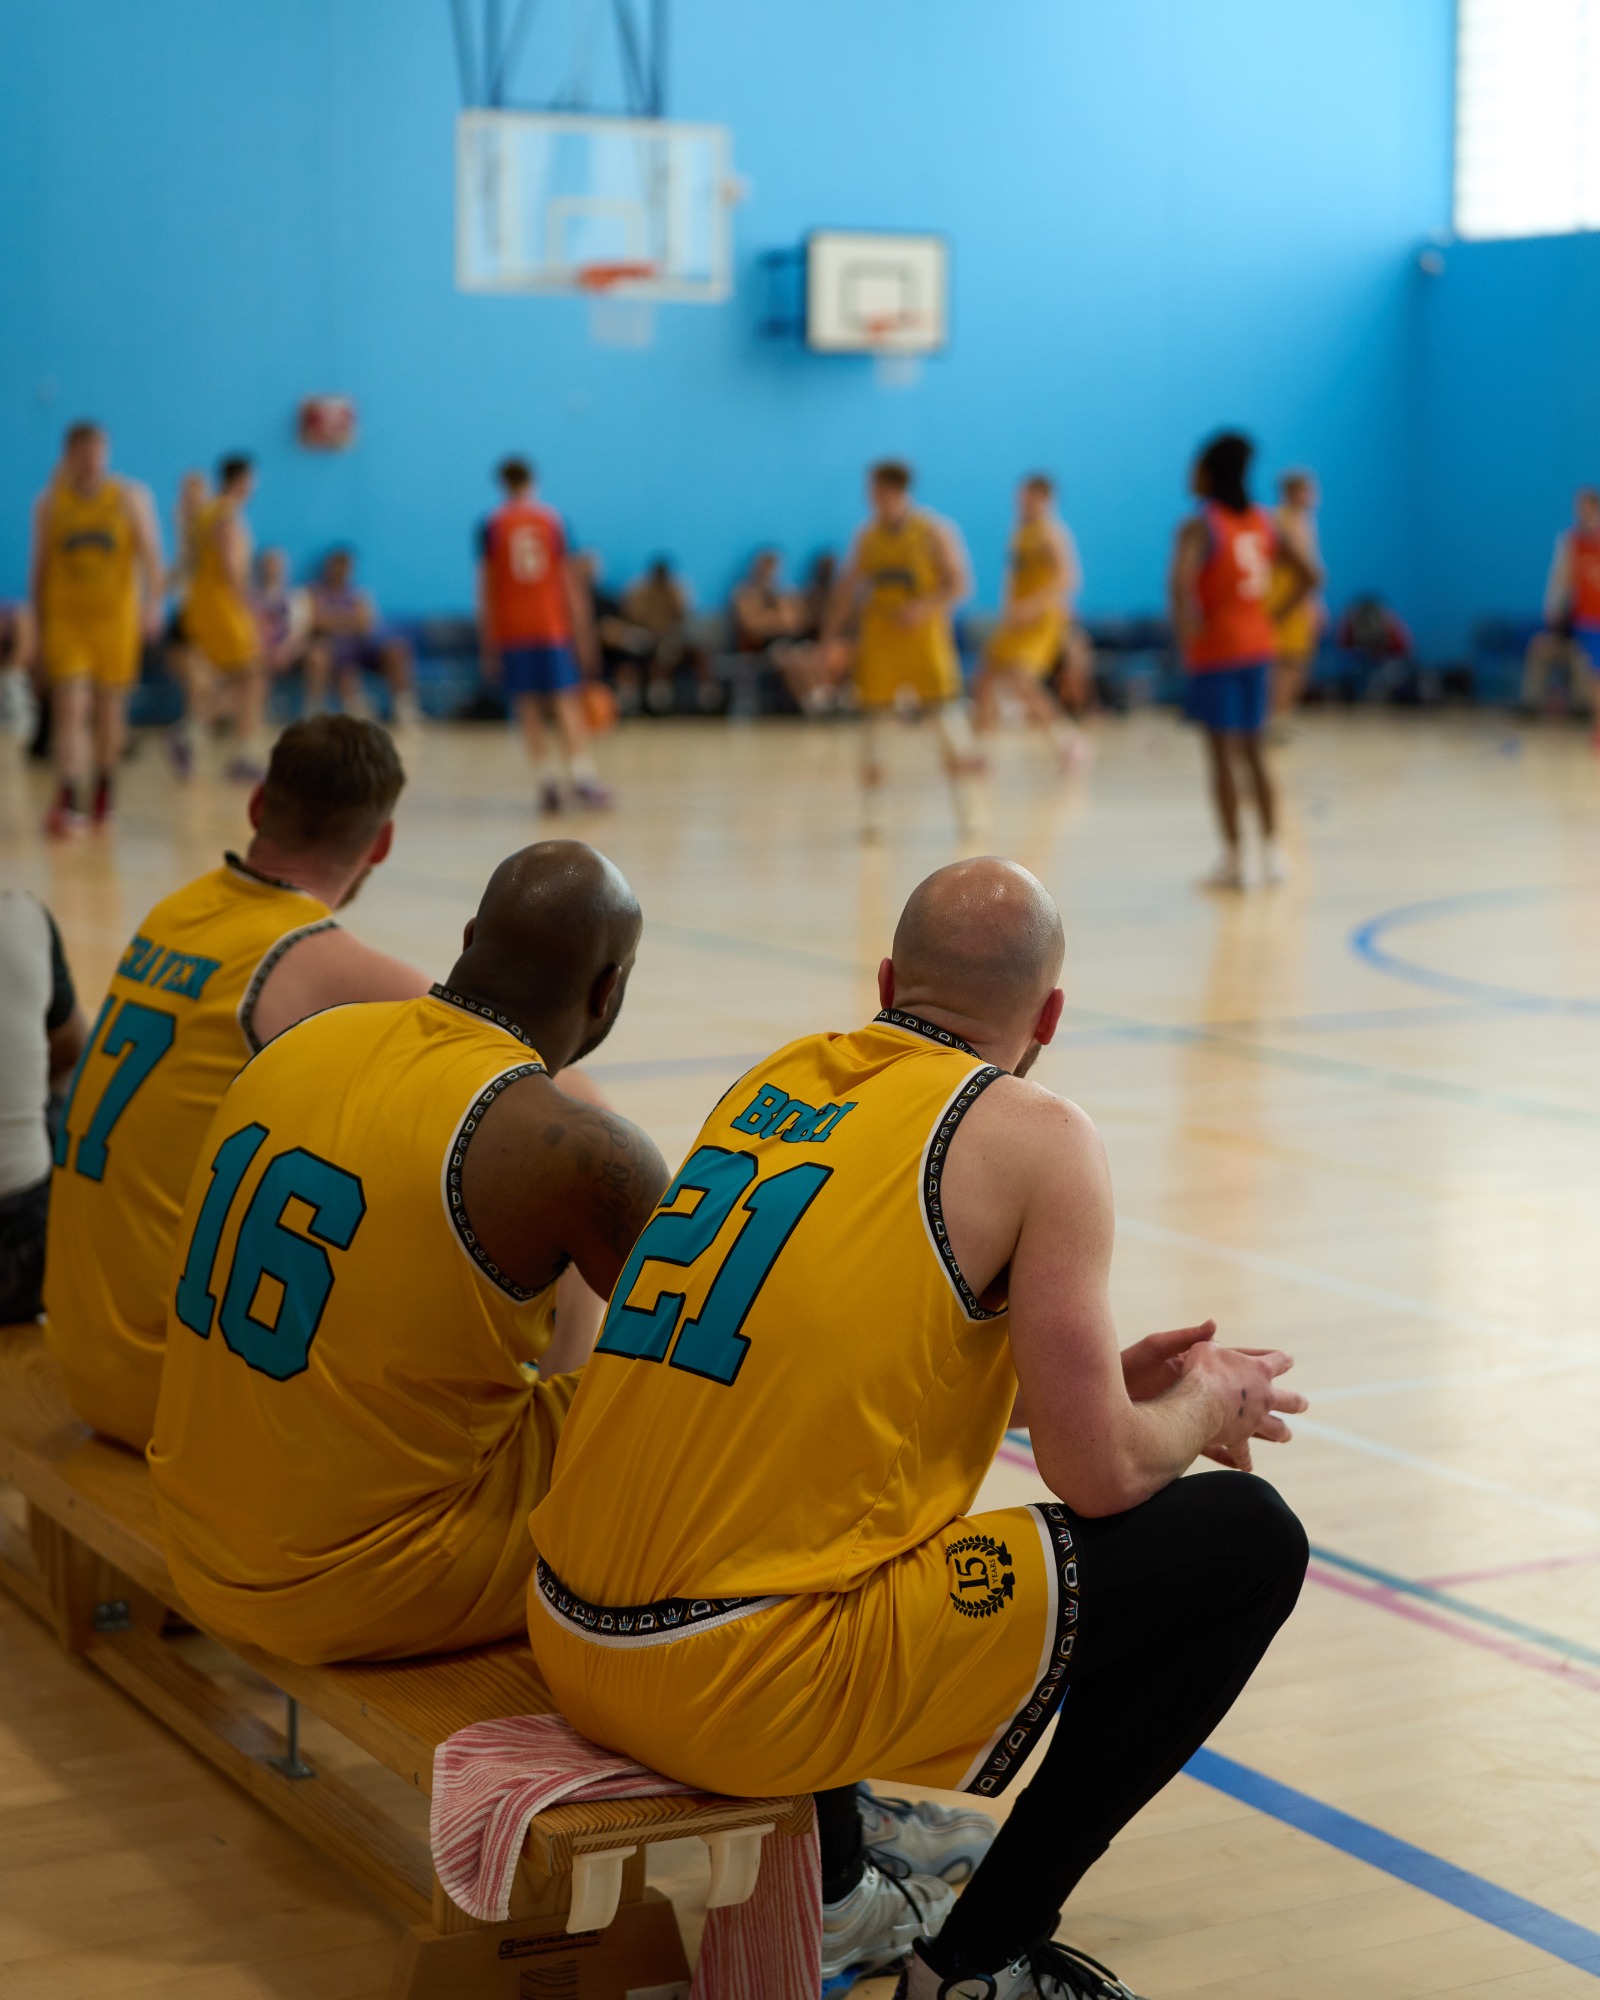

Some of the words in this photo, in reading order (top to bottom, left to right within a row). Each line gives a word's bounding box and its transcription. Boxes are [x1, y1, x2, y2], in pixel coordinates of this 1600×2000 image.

[53, 994, 177, 1183] 17
[176, 1121, 367, 1382] 16
[593, 1145, 834, 1387] 21
[954, 1557, 990, 1593] 15
[990, 1559, 999, 1584] YEARS
